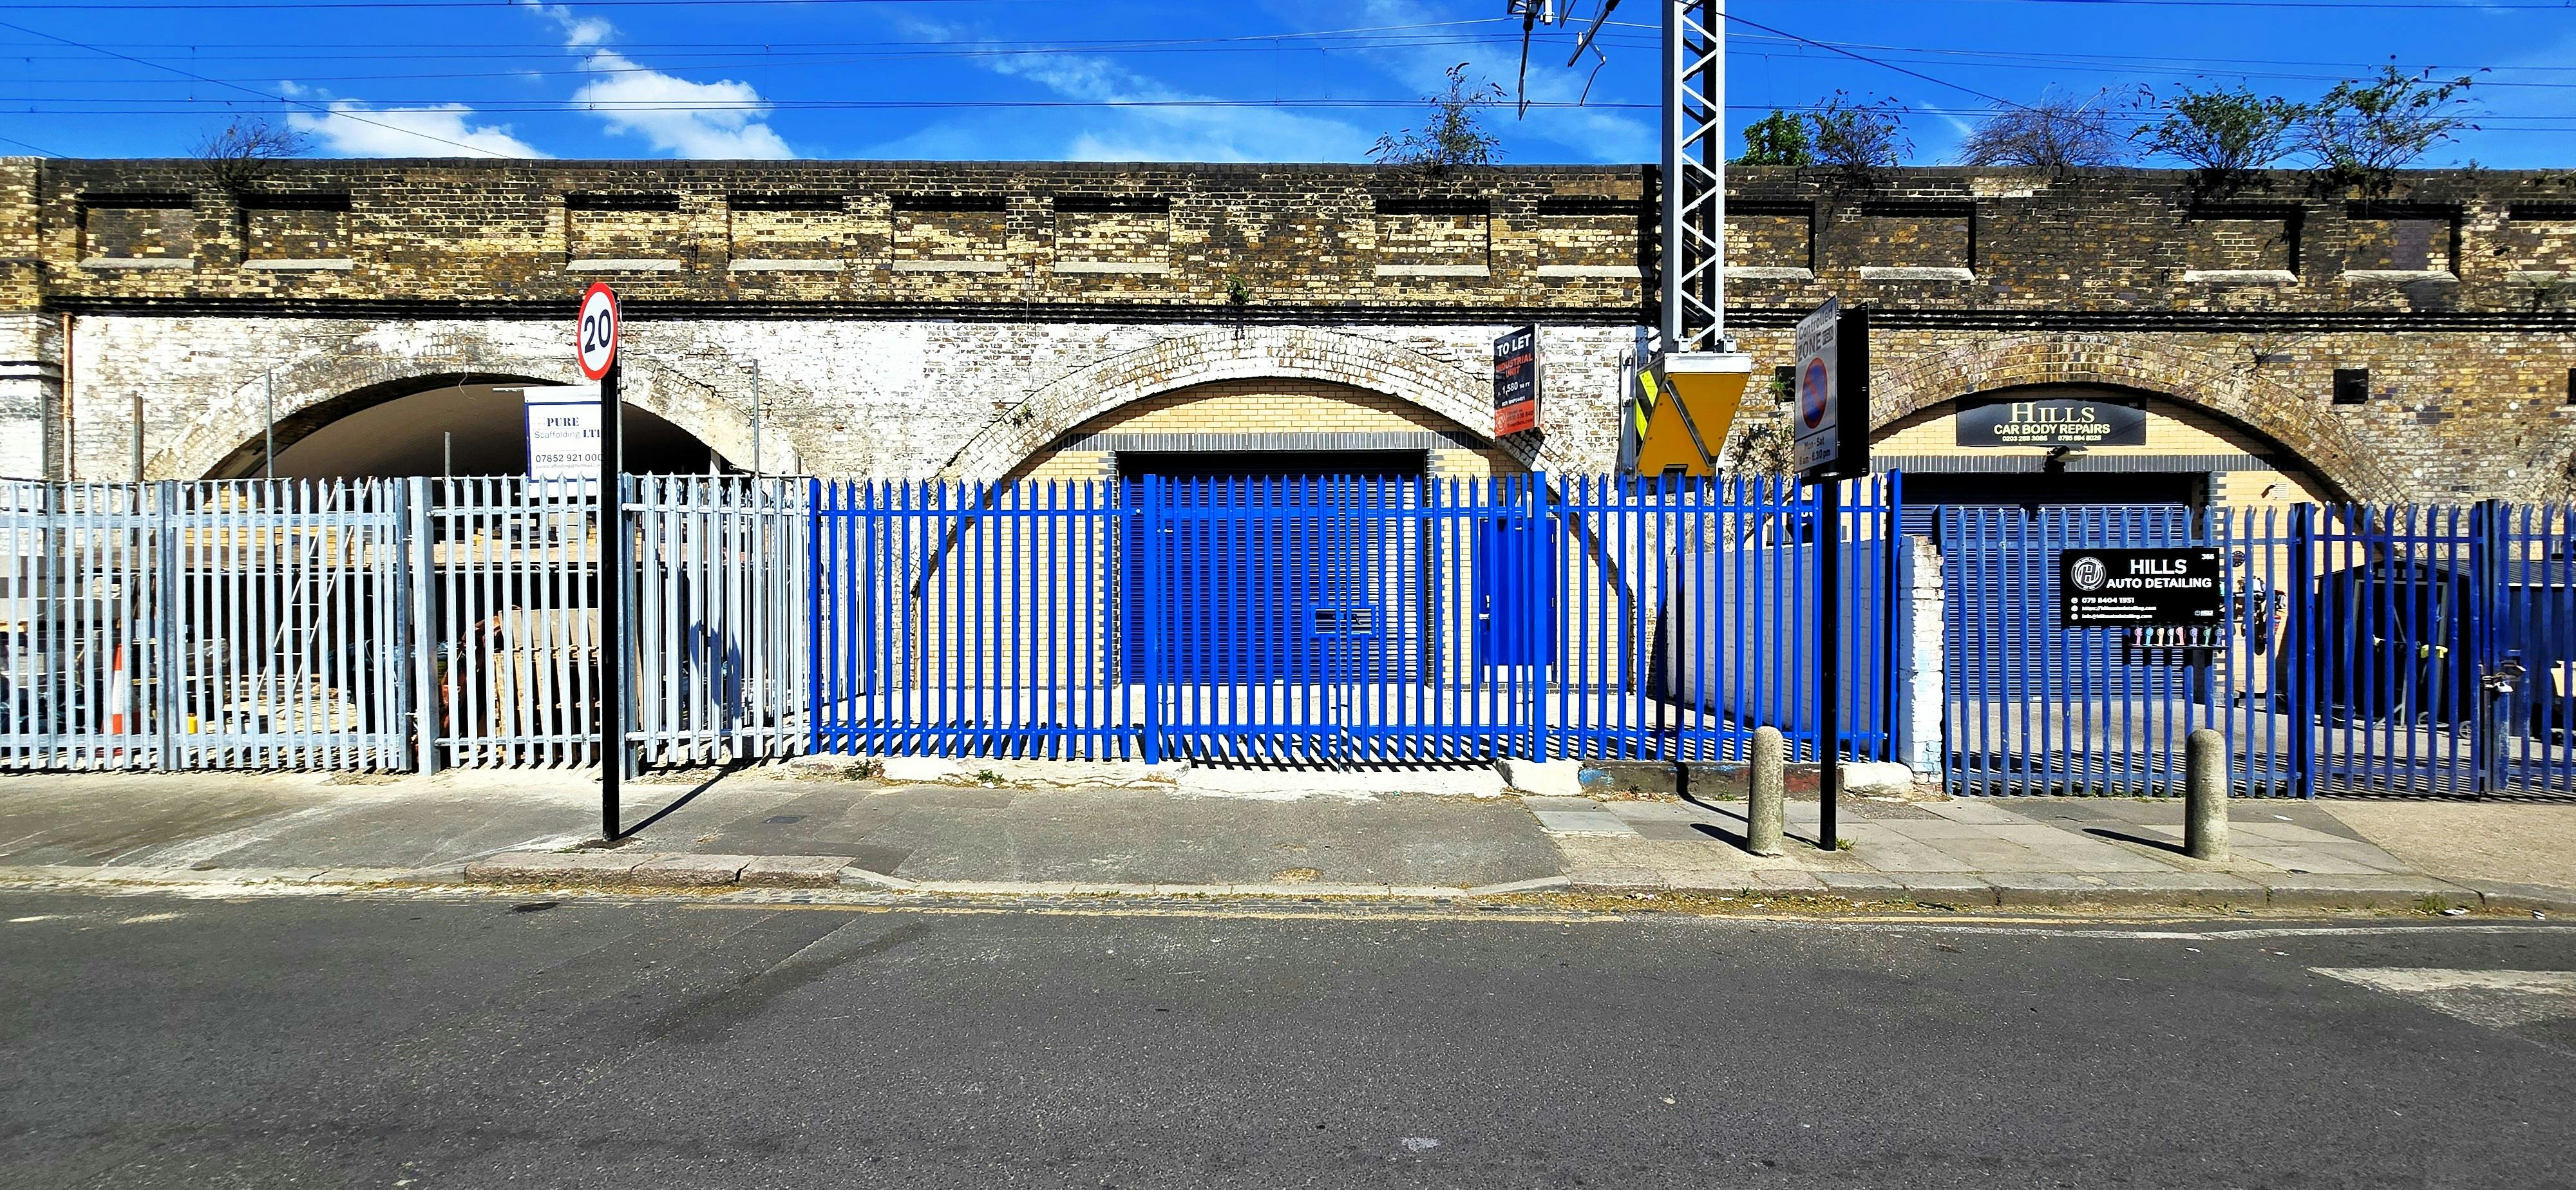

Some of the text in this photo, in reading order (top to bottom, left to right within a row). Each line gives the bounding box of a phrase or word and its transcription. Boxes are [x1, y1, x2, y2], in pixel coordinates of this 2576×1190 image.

[1799, 305, 1833, 340] Controlled
[583, 309, 611, 354] 20
[1497, 334, 1531, 357] TO LET
[1798, 332, 1821, 363] ZONE
[1496, 353, 1533, 373] INDUSTRIAL
[1506, 365, 1521, 378] UNIT
[1502, 381, 1519, 395] 1,580
[547, 417, 580, 426] PURE
[535, 431, 581, 439] Scaffolding
[1994, 424, 2111, 435] CAR BODY REPAIRS
[2130, 559, 2187, 574] HILLS
[2106, 578, 2212, 589] AUTO DETAILING
